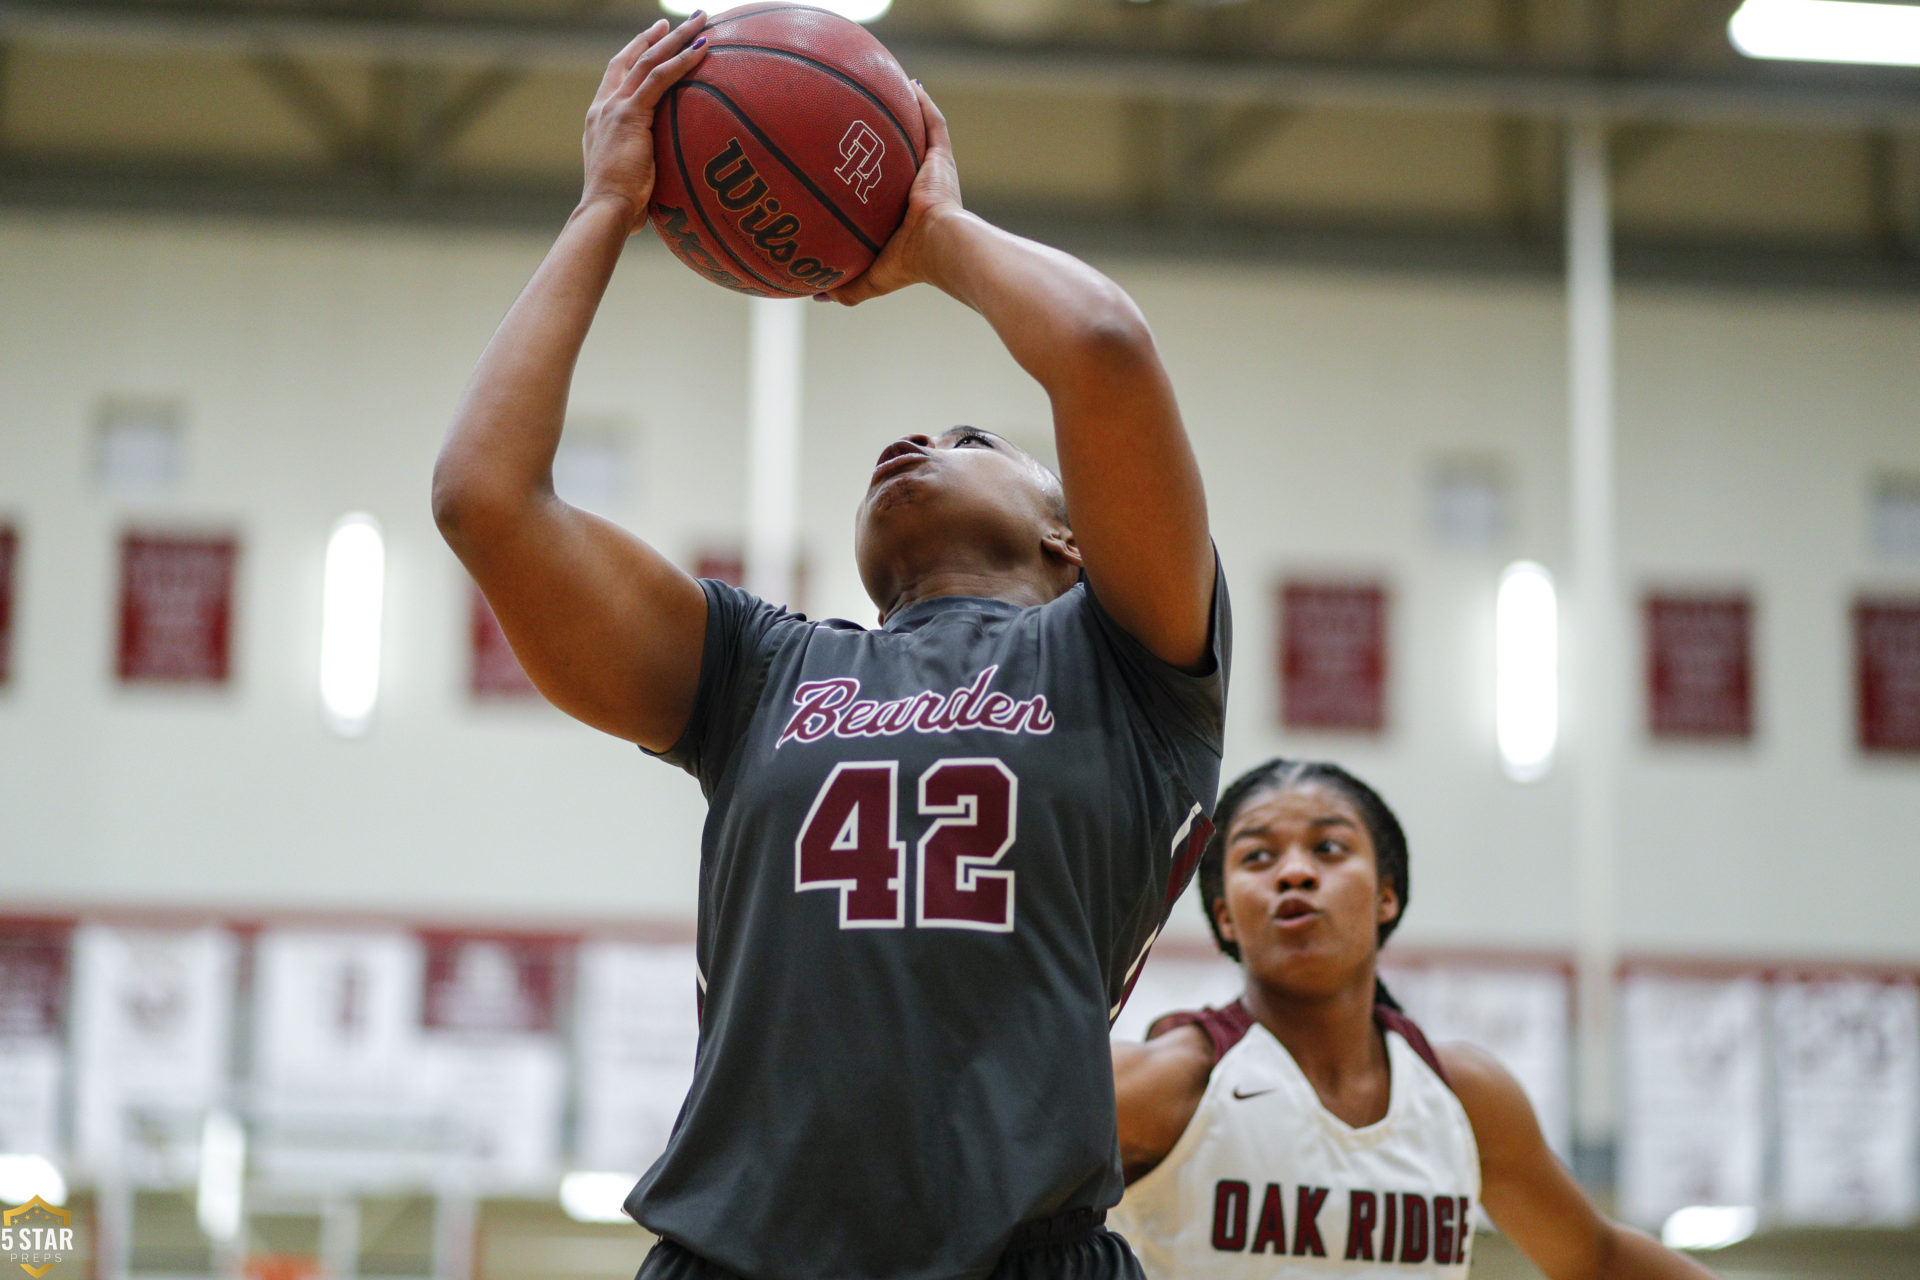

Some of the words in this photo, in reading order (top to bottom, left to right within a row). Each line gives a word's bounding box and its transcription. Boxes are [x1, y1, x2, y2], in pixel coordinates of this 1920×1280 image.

[703, 136, 846, 288] Wilson
[775, 664, 1054, 749] Bearden
[794, 757, 1018, 933] 42
[1211, 1179, 1330, 1258] OAK
[1343, 1189, 1469, 1265] RIDGE
